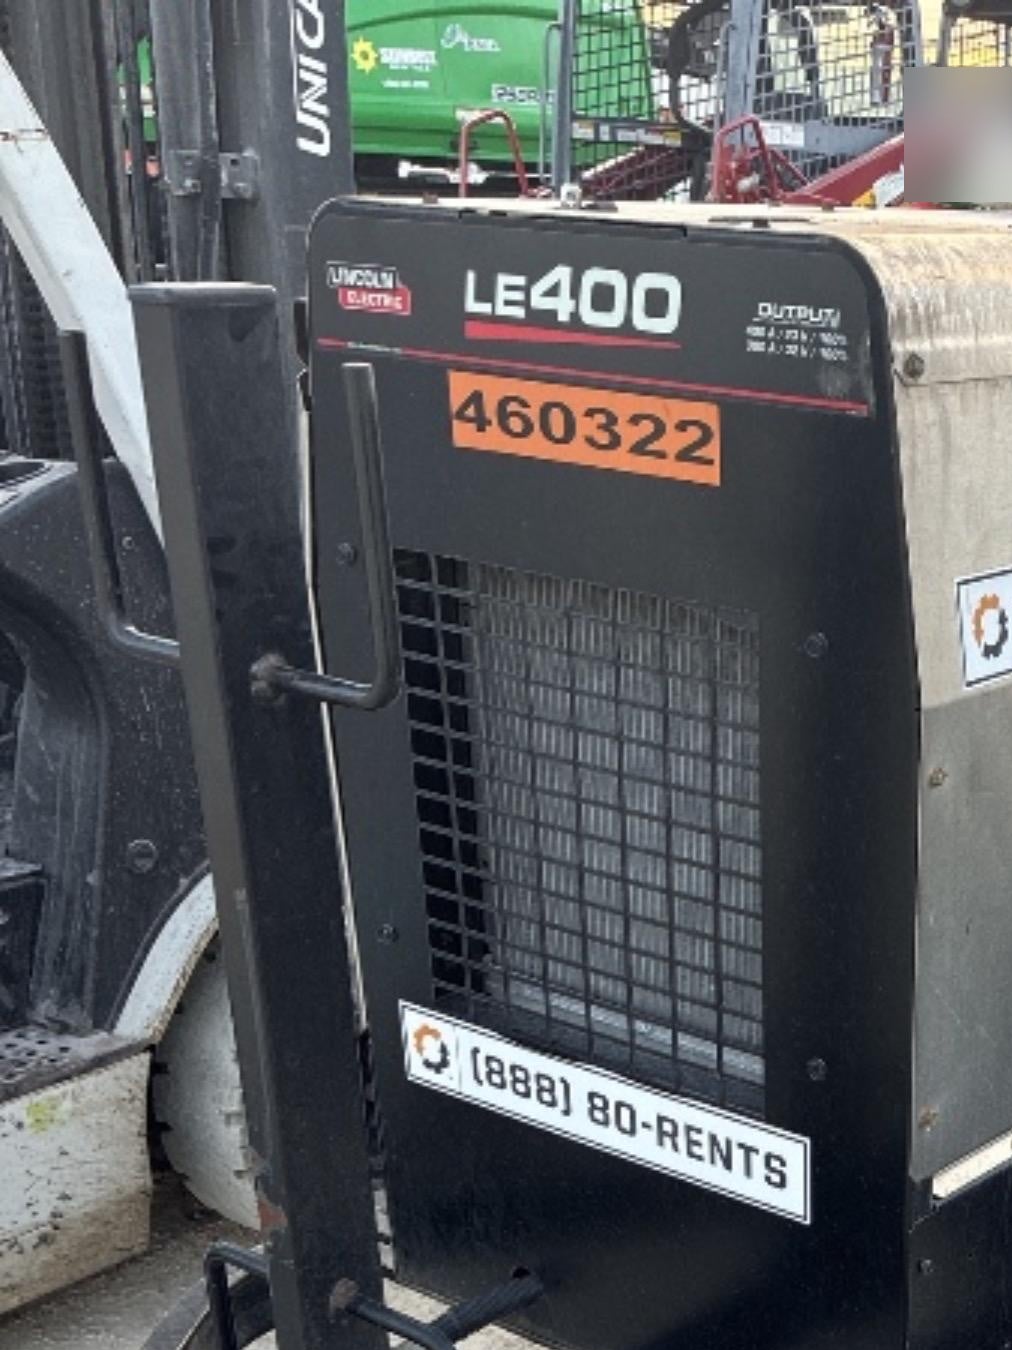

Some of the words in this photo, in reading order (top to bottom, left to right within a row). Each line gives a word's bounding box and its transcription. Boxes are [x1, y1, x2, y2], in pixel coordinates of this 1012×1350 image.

[330, 266, 395, 290] LINCOLN
[346, 289, 404, 311] ELECTRIC
[463, 263, 683, 335] LE400
[453, 389, 715, 466] 460322
[471, 1046, 572, 1117] (888)
[587, 1090, 789, 1190] 80-RENTS
